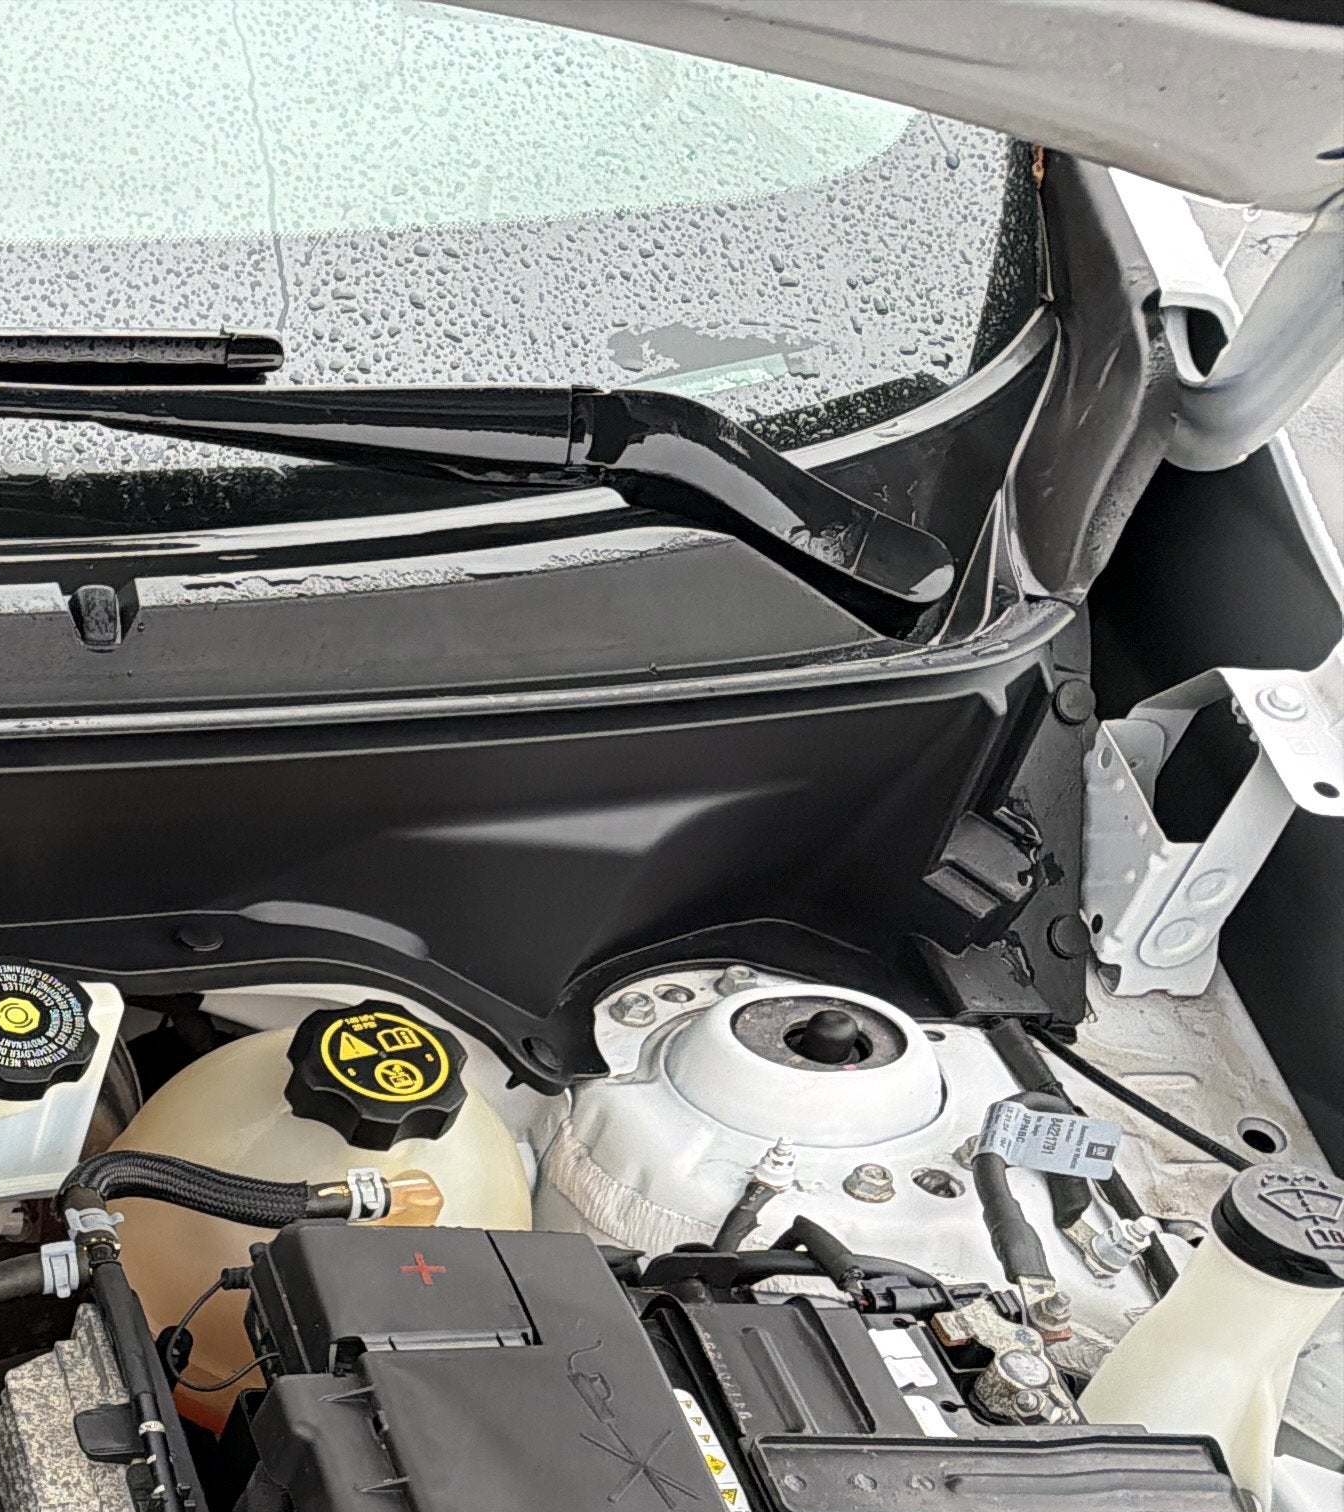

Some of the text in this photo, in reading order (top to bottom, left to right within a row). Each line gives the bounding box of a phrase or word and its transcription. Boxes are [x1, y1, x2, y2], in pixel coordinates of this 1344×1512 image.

[19, 974, 34, 985] USE
[42, 973, 70, 995] SEALED
[1, 981, 31, 993] FILLER
[30, 987, 54, 1006] CLEAN
[0, 1036, 48, 1050] PROVENANT
